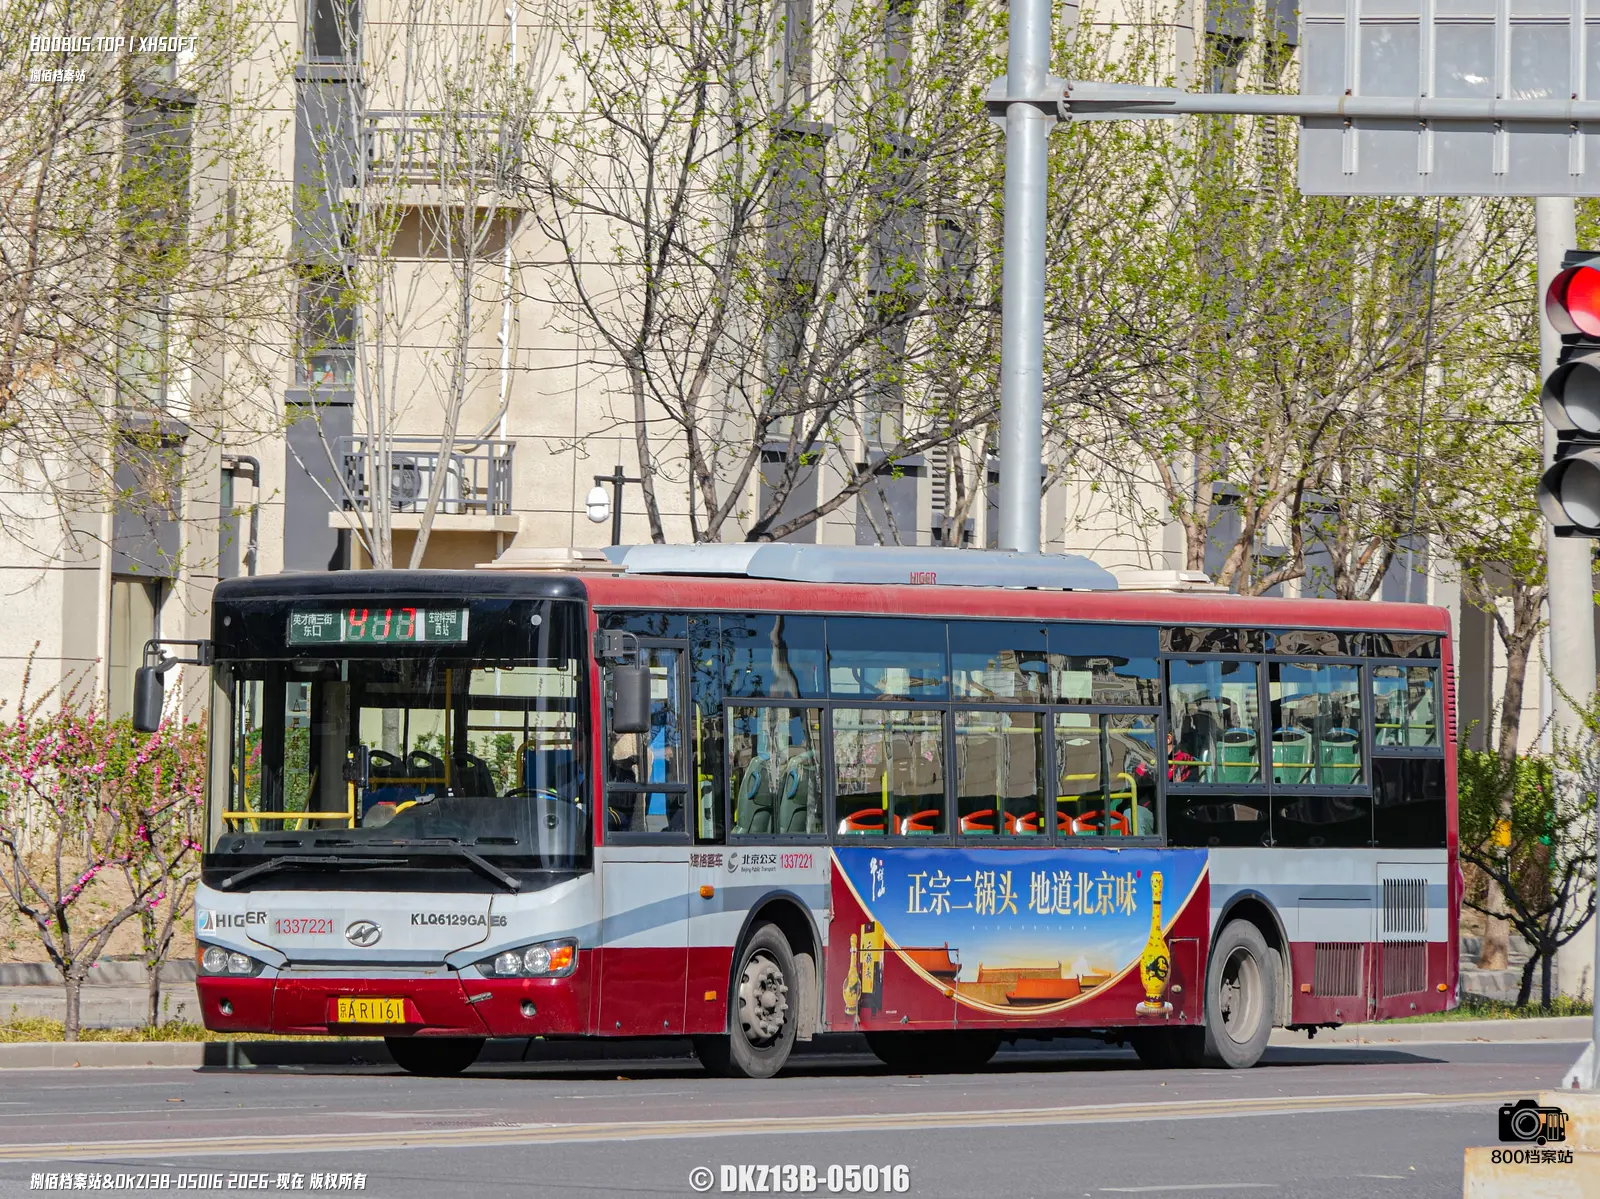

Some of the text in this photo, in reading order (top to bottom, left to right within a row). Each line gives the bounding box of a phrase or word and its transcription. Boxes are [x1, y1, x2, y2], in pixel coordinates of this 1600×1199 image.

[909, 571, 937, 585] HIGER
[292, 613, 333, 626] 英才南三街
[348, 607, 417, 640] 417
[303, 625, 322, 637] 东口
[741, 853, 778, 865] 北京公交
[779, 853, 813, 869] 1337221
[906, 870, 1138, 917] 正宗二锅头 地道北京味
[215, 911, 267, 928] HIGER
[275, 918, 335, 934] 1337221
